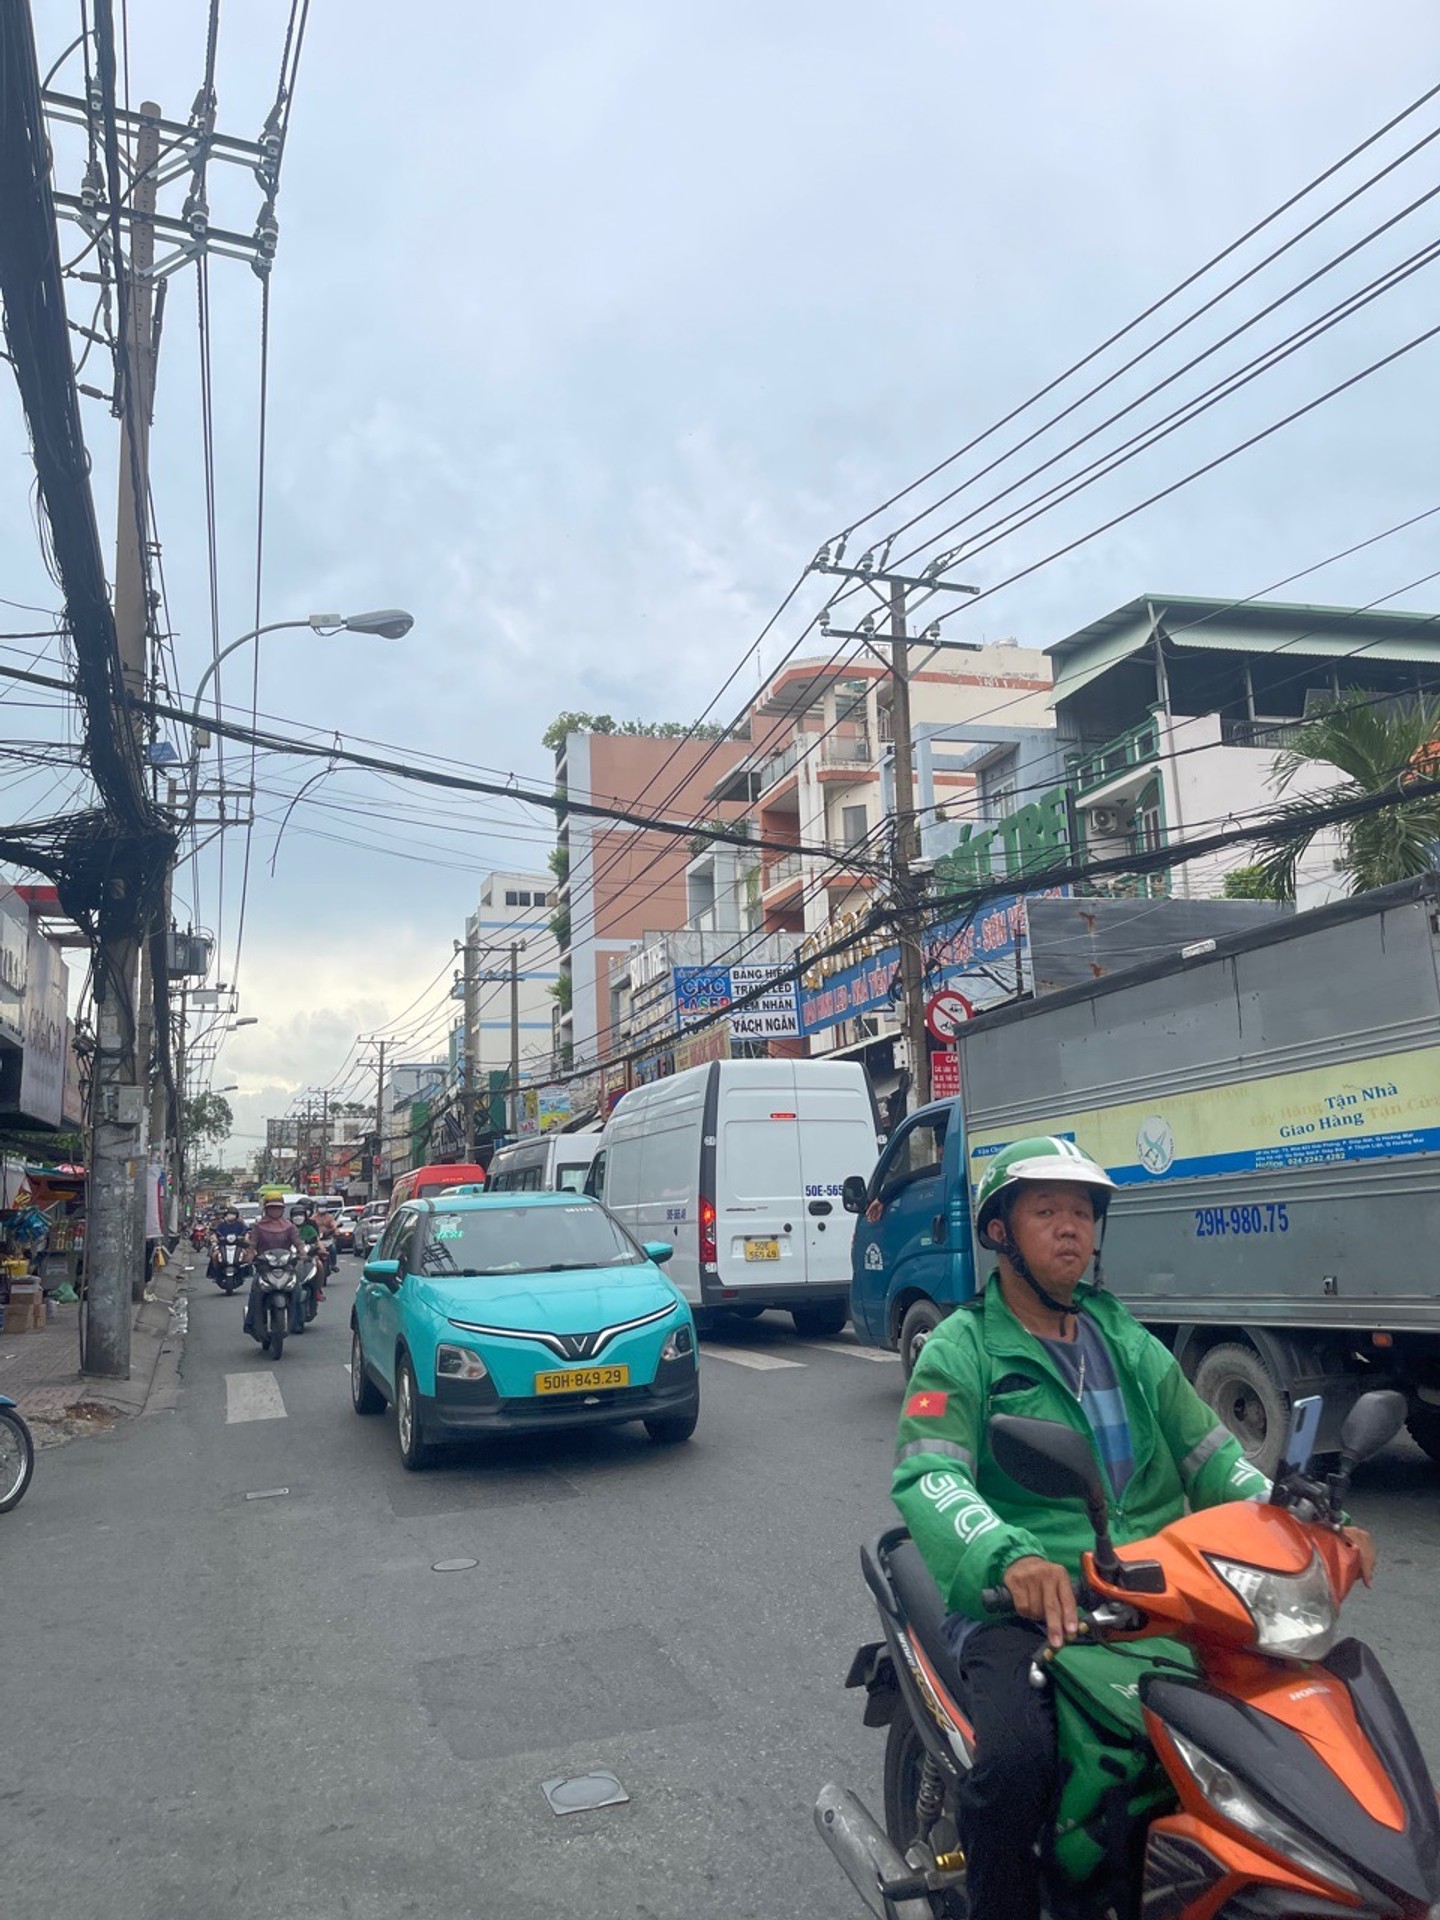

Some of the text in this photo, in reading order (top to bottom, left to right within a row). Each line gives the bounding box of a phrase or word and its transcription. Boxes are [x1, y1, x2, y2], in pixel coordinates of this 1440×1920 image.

[682, 978, 725, 996] CNC
[733, 1015, 763, 1033] VÁCH
[1324, 1082, 1398, 1110] Tận Nhà
[1279, 1111, 1365, 1138] Giao Hàng
[1195, 1203, 1289, 1237] 29H-980.75
[543, 1370, 621, 1390] 50H-849.29
